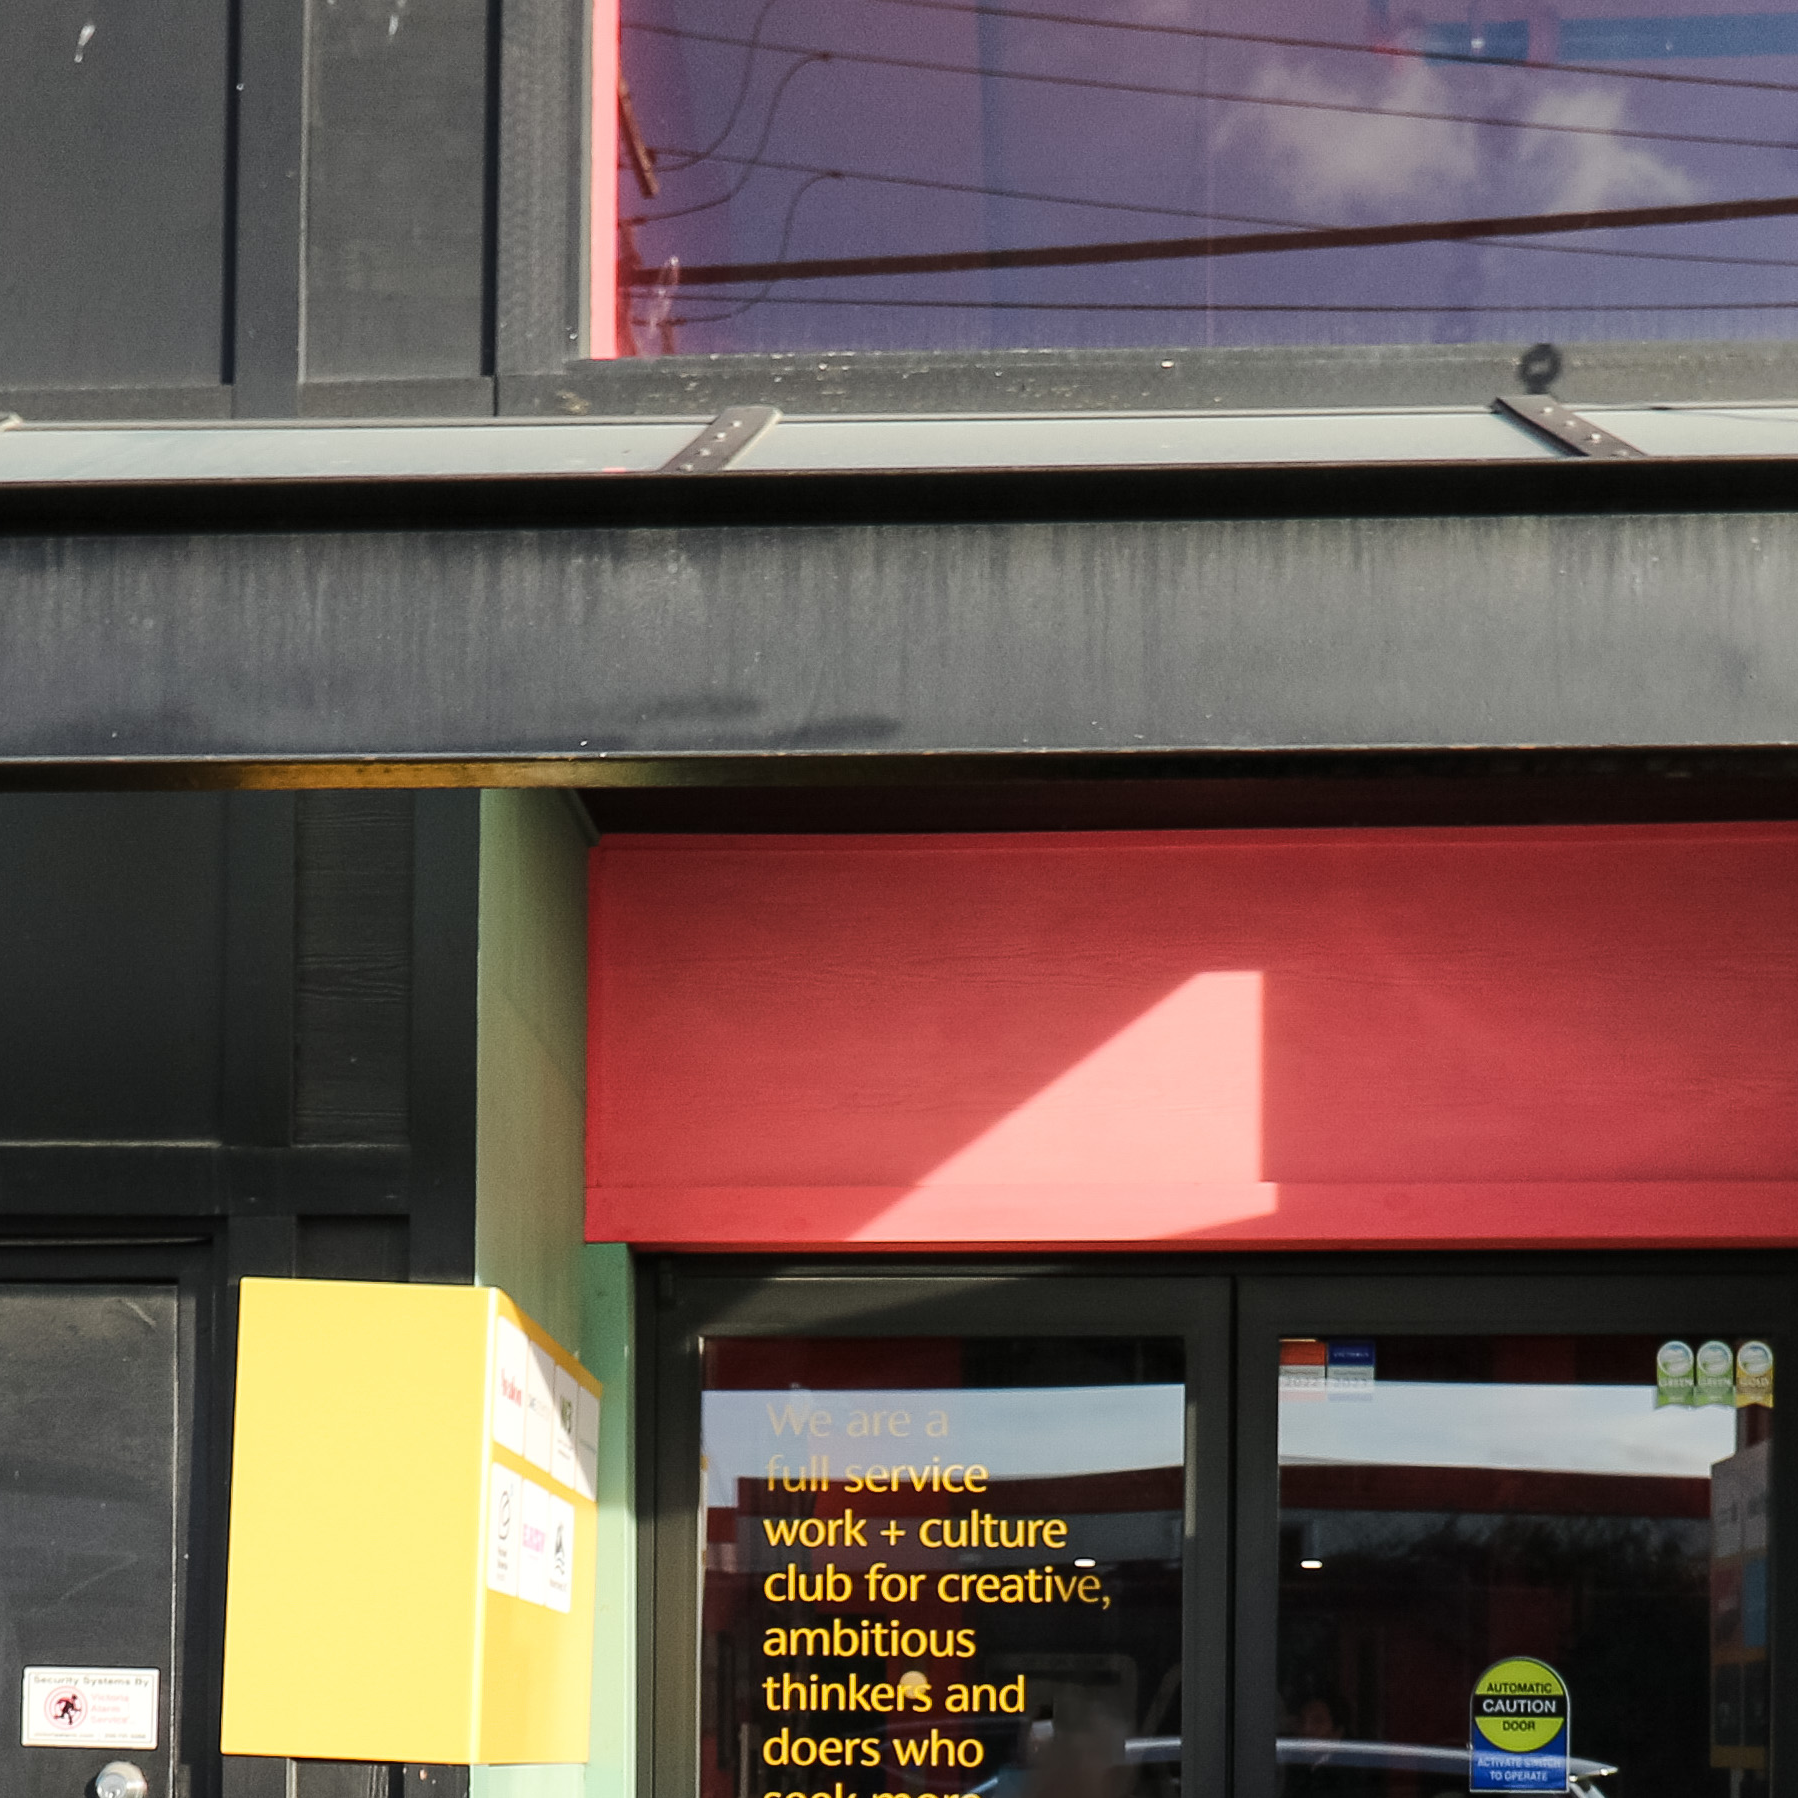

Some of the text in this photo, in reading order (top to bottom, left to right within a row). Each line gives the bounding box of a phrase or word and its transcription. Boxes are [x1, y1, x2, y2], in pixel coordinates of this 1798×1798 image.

[767, 1402, 949, 1438] We are a
[765, 1454, 990, 1494] full service
[763, 1509, 868, 1549] work
[918, 1509, 1069, 1549] culture
[763, 1562, 1112, 1610] club for creative,
[762, 1618, 977, 1659] ambitious
[33, 1675, 150, 1688] Security Systems By
[762, 1672, 1026, 1714] thinkers and
[1486, 1682, 1553, 1694] AUTOMATIC
[90, 1693, 130, 1702] Victoria
[90, 1704, 121, 1713] Alarm
[1482, 1698, 1557, 1714] CAUTION
[1502, 1720, 1536, 1732] DOOR
[762, 1727, 985, 1768] doers who
[1490, 1770, 1549, 1782] TO OPERATE
